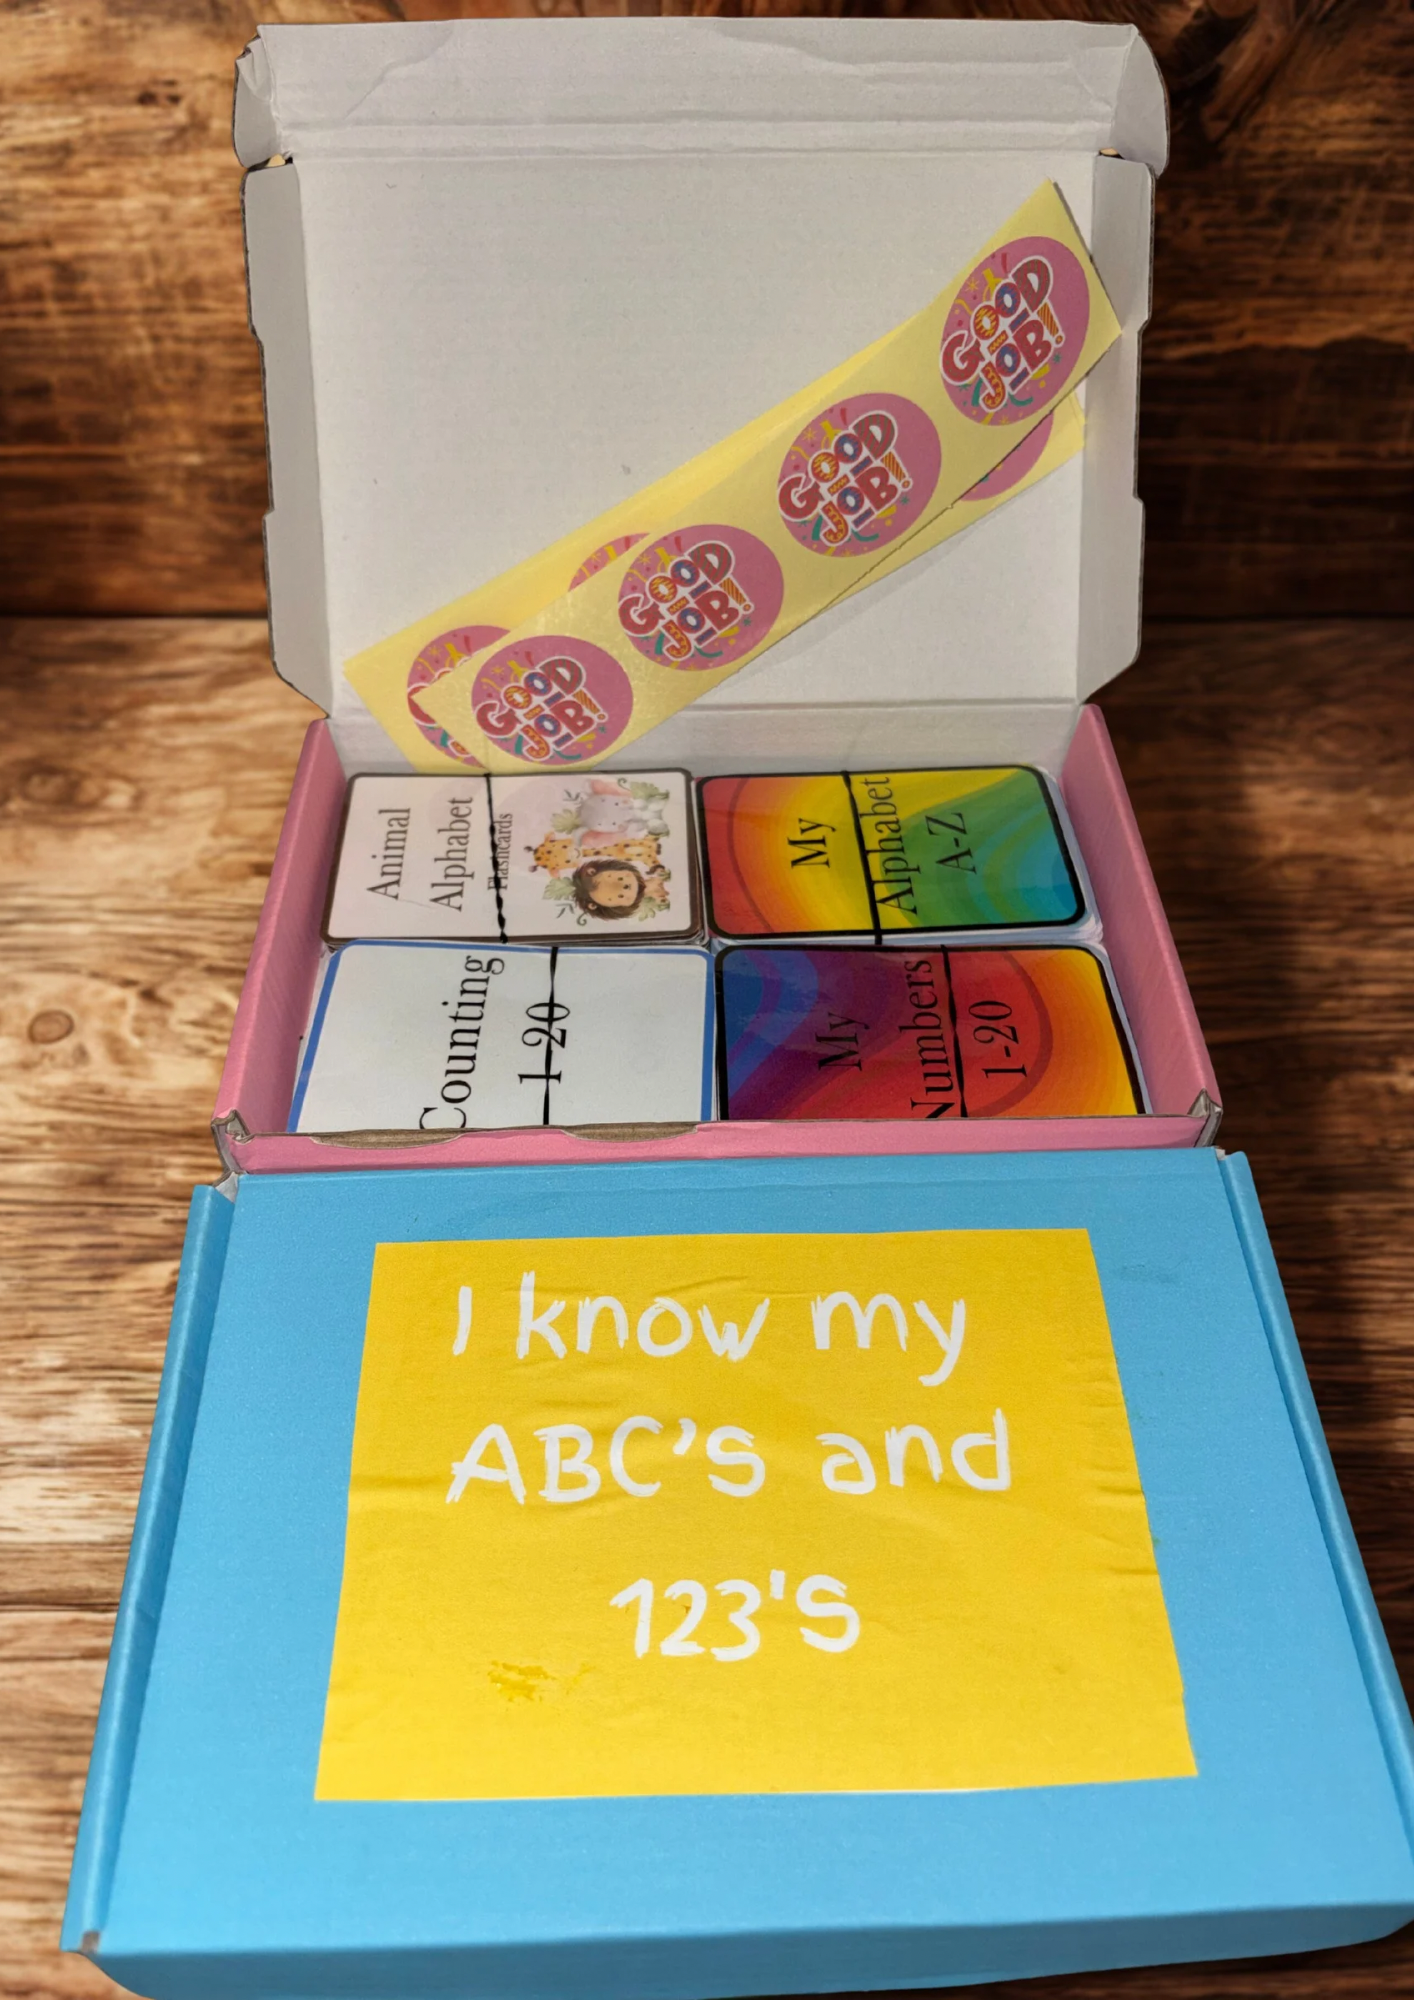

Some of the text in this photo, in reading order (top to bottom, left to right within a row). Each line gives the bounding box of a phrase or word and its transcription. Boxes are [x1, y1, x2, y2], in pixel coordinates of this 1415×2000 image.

[940, 255, 1053, 385] GOOD
[979, 300, 1066, 412] JOB!
[777, 410, 897, 521] GOOD
[820, 450, 912, 546] JOB!
[618, 540, 735, 637] GOOD
[661, 577, 754, 661] JOB!
[475, 656, 586, 738] GOOD
[521, 689, 608, 761] JOB!
[366, 808, 411, 900] Animal
[430, 797, 474, 912] Alphabet
[787, 818, 836, 869] My
[859, 776, 920, 915] Alphabet
[925, 812, 977, 875] A-Z
[419, 955, 505, 1129] Counting
[518, 1002, 570, 1084] 120
[815, 1012, 870, 1072] My
[968, 1000, 1028, 1079] 1-20
[452, 1270, 967, 1387] I know my
[816, 1408, 1012, 1493] and
